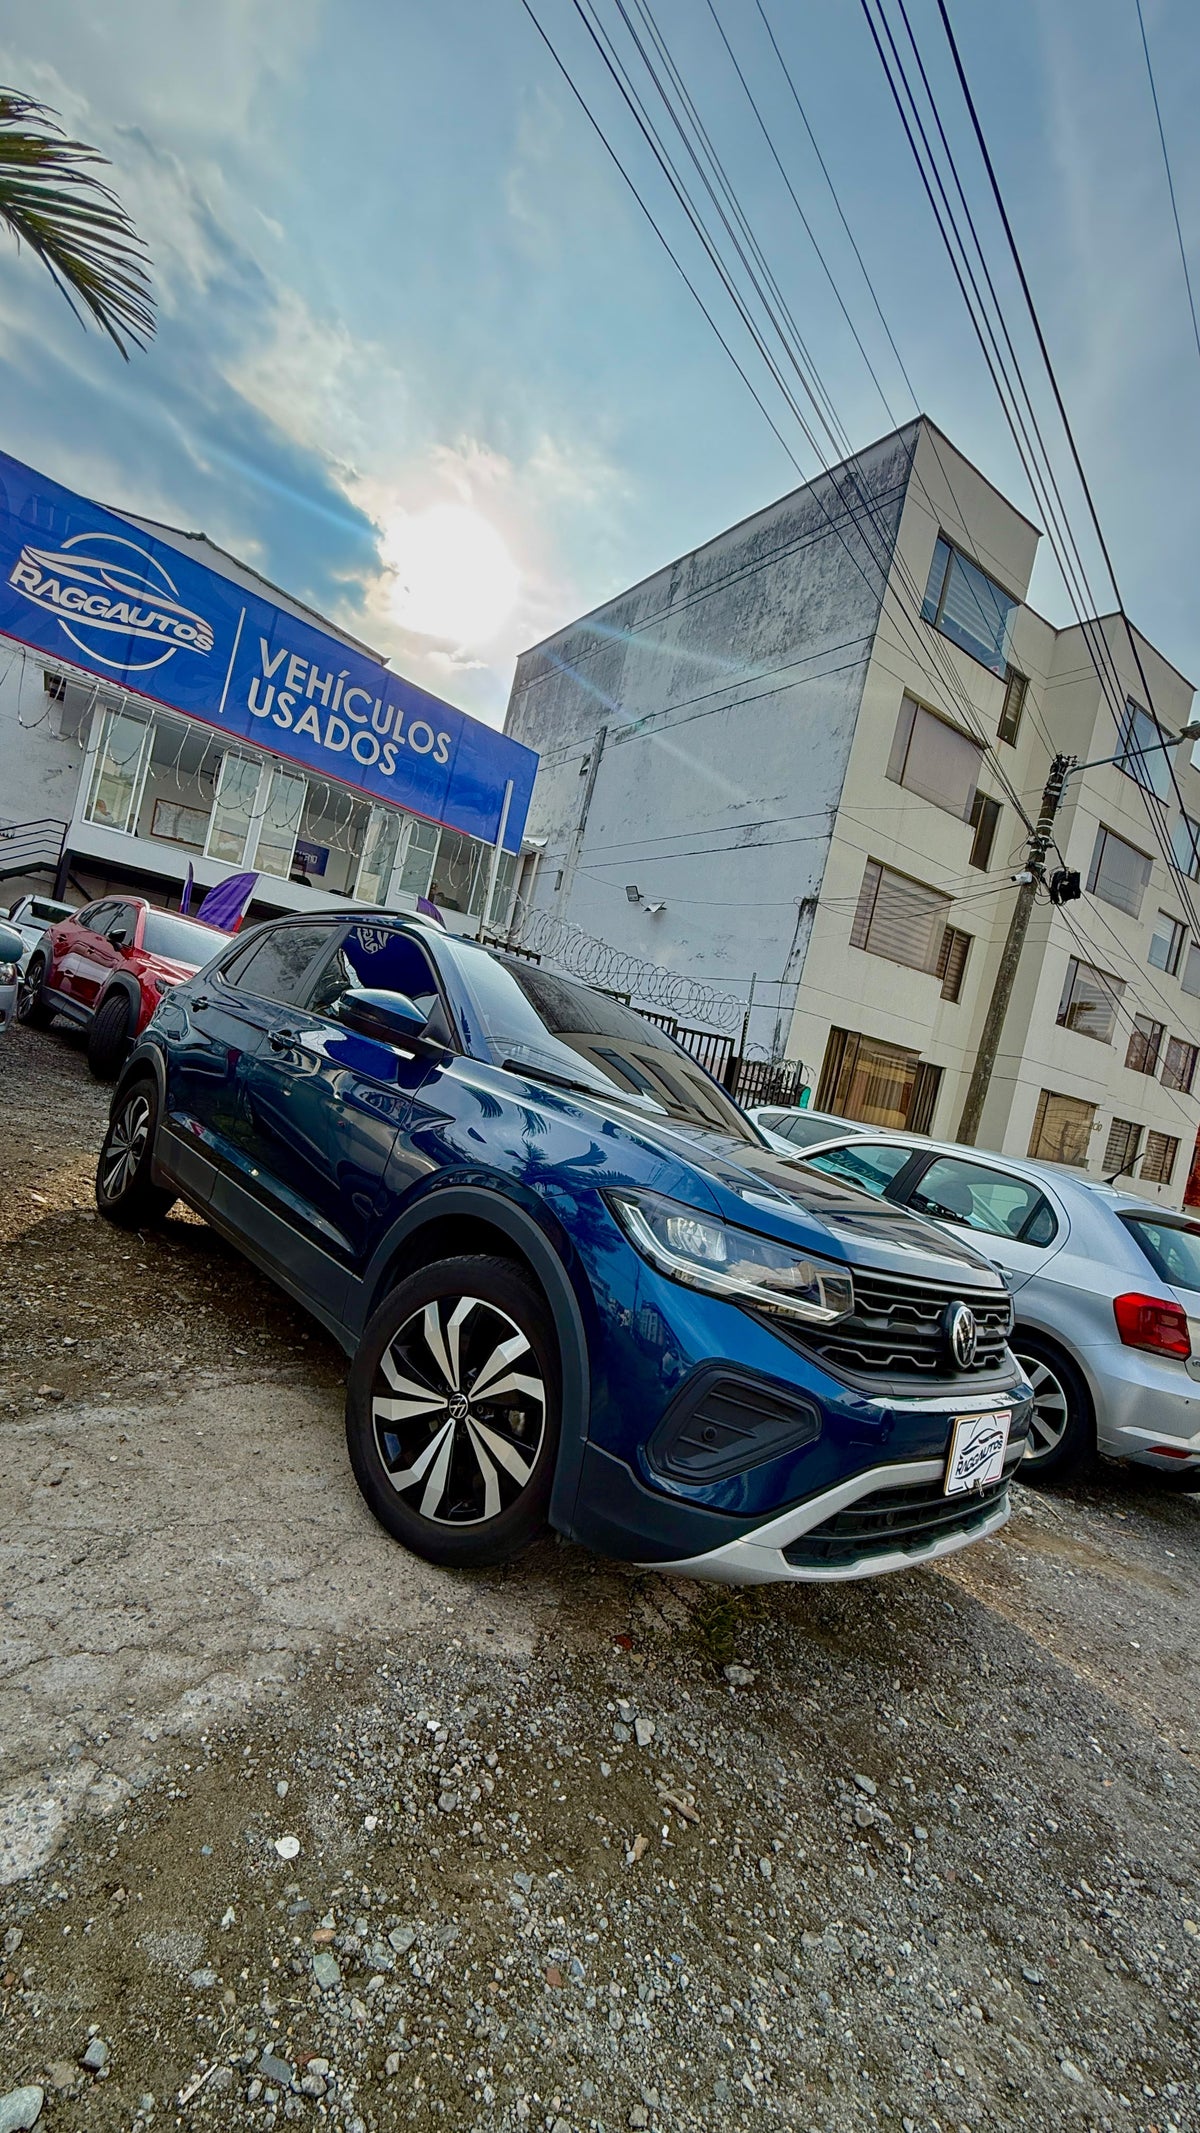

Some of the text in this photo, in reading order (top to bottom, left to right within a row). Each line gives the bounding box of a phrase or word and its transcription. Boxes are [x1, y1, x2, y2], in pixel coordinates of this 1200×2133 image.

[10, 562, 214, 651] RAGGAUTOS
[248, 677, 399, 776] USADOS
[260, 637, 452, 764] VEHÍCULOS
[955, 1439, 1004, 1476] RAGGAUTOS
